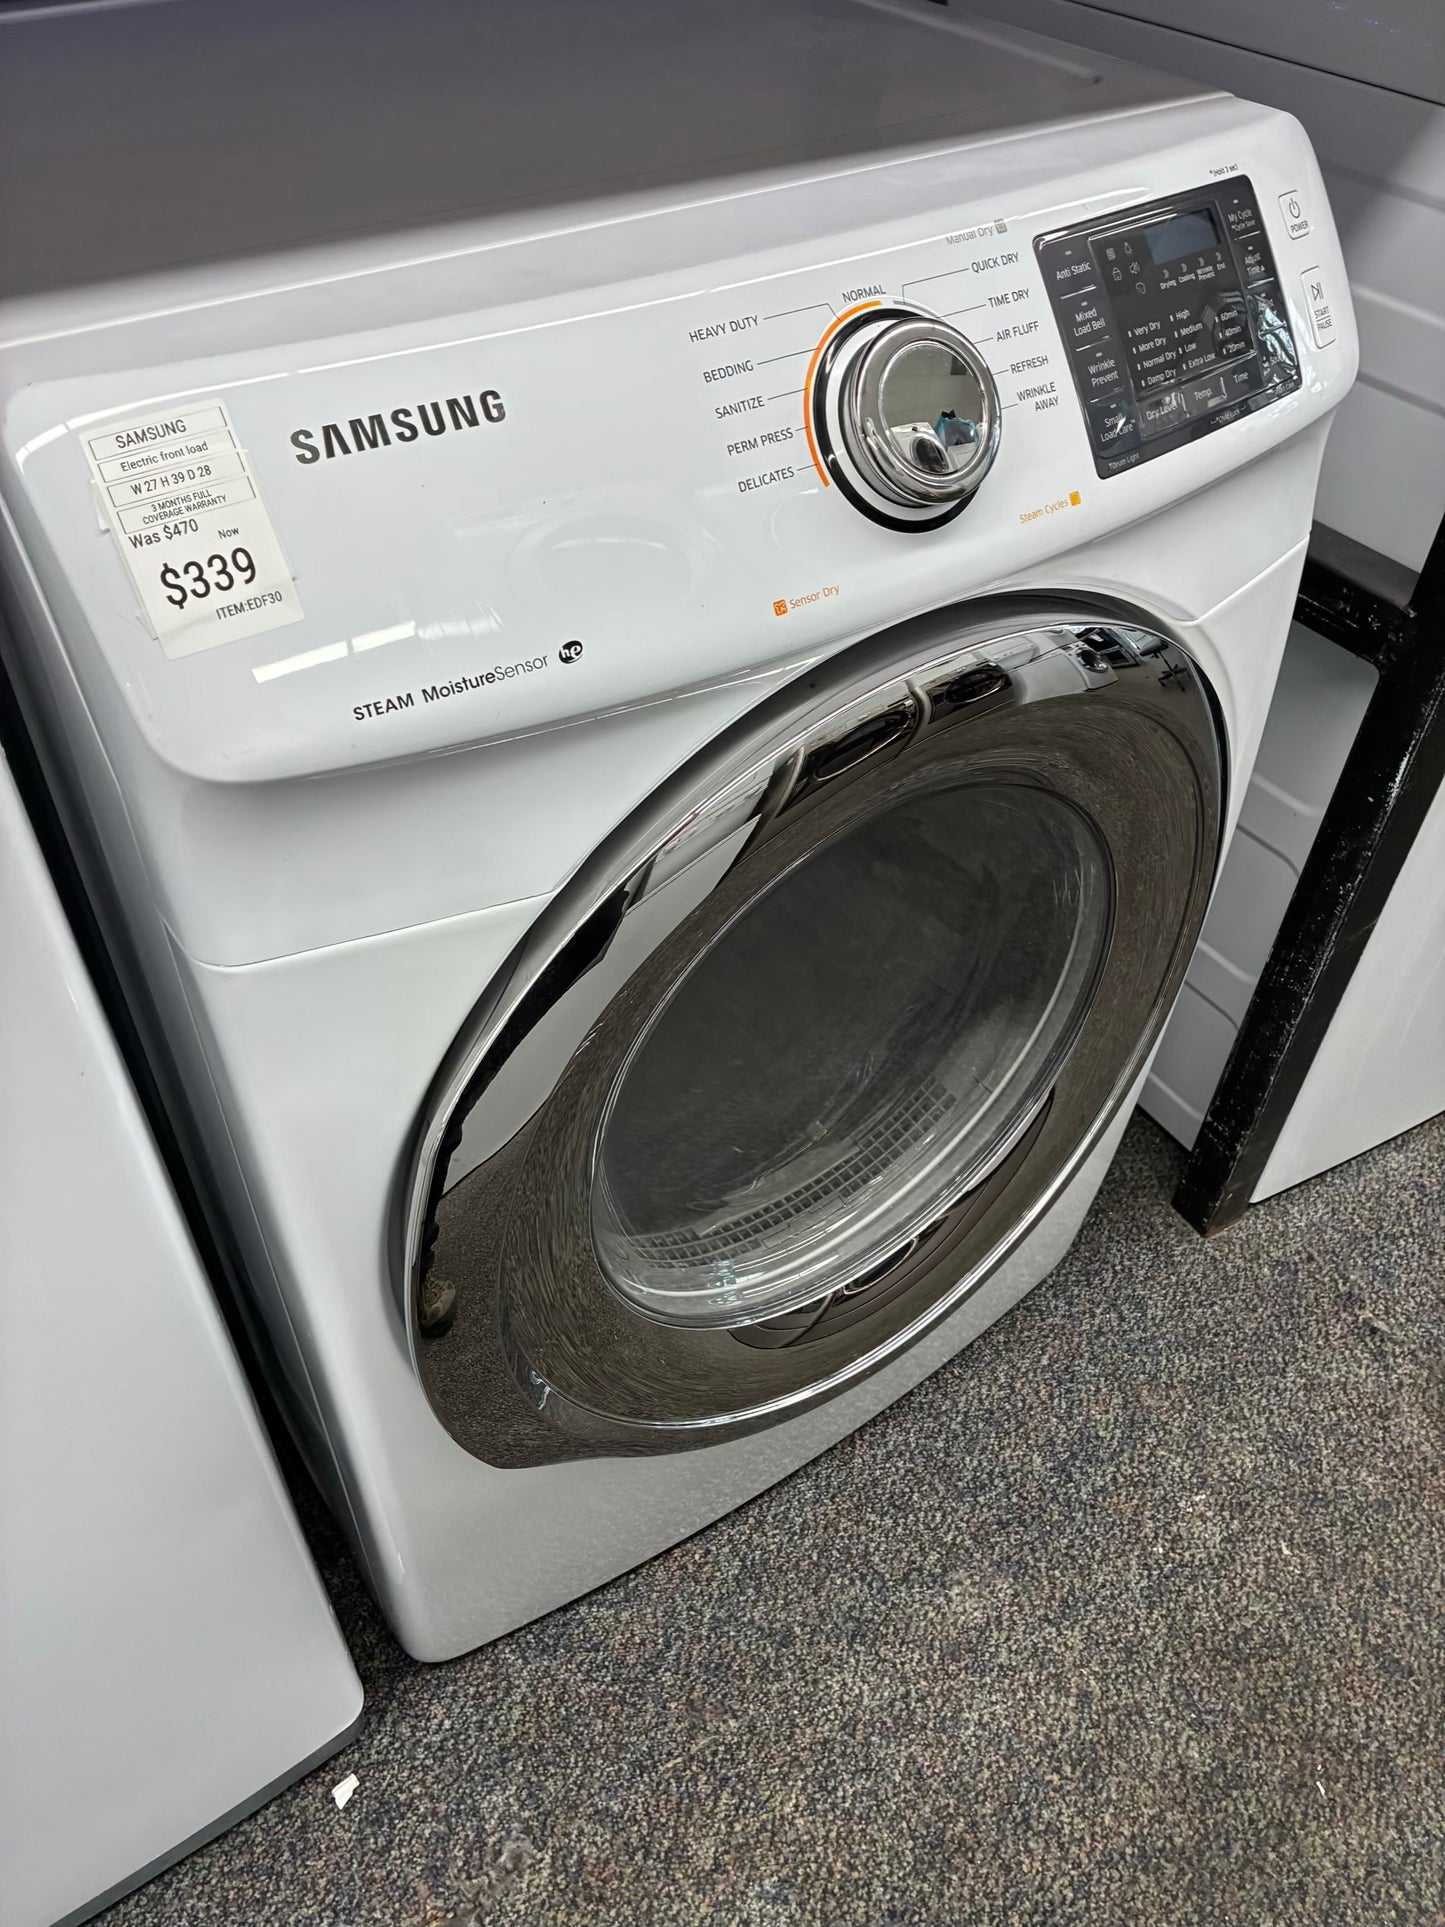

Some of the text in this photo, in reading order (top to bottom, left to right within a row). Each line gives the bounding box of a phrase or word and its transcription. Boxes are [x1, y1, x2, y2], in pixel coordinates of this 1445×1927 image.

[1228, 209, 1252, 223] My Cycle
[1290, 220, 1309, 233] POWER
[945, 226, 993, 246] Manual Dry
[971, 252, 1019, 273] QUICK DRY
[1056, 261, 1091, 280] Anti Static
[1216, 262, 1226, 271] End
[1160, 280, 1177, 290] Drying
[1178, 273, 1196, 283] Cooling
[842, 283, 886, 303] NORMAL
[988, 288, 1030, 308] TIME DRY
[1075, 307, 1098, 322] Mixed
[1175, 309, 1190, 320] High
[1221, 310, 1238, 321] 60min
[1314, 306, 1330, 319] START
[688, 315, 759, 343] HEAVY DUTY
[996, 321, 1040, 342] AIR FLUFF
[1073, 318, 1106, 337] Load Bell
[1133, 321, 1161, 337] Very Dry
[1180, 322, 1203, 336] Medium
[1225, 326, 1242, 337] 40min
[1317, 318, 1333, 330] PAUSE
[1138, 336, 1166, 352] More Dry
[1184, 342, 1197, 352] Low
[1228, 341, 1246, 353] 20min
[1010, 355, 1049, 375] REFRESH
[1088, 359, 1115, 375] Wrinkle
[1143, 350, 1177, 368] Normal Dry
[1188, 353, 1216, 369] Extra Low
[703, 360, 754, 383] BEDDING
[1091, 371, 1119, 387] Prevent
[1147, 368, 1177, 386] Damp Dry
[1233, 372, 1249, 385] Time
[1017, 382, 1057, 402] WRINKLE
[1194, 388, 1212, 401] Temp.
[715, 396, 765, 419] SANITIZE
[1034, 395, 1060, 412] AWAY
[1146, 403, 1178, 420] Dry Level
[290, 389, 506, 465] SAMSUNG
[1104, 412, 1123, 428] Small
[115, 419, 187, 449] SAMSUNG
[726, 427, 794, 457] PERM PRESS
[1101, 429, 1117, 442] Load
[120, 441, 209, 472] Electric front load
[1127, 453, 1140, 466] Light
[131, 465, 212, 496] W 27 H 39 D 28
[738, 466, 795, 493] DELICATES
[157, 494, 192, 511] MONTHS
[192, 489, 212, 502] FULL
[142, 494, 227, 525] COVERAGE WARRANTY
[1019, 498, 1069, 524] Steam Cycles
[128, 518, 199, 549] Was $470
[218, 526, 240, 539] Now
[160, 547, 256, 610] $339
[216, 590, 283, 620] ITEM:EDF30
[789, 585, 840, 609] Sensor Dry
[353, 693, 415, 721] STEAM
[421, 653, 549, 703] MoistureSensor
